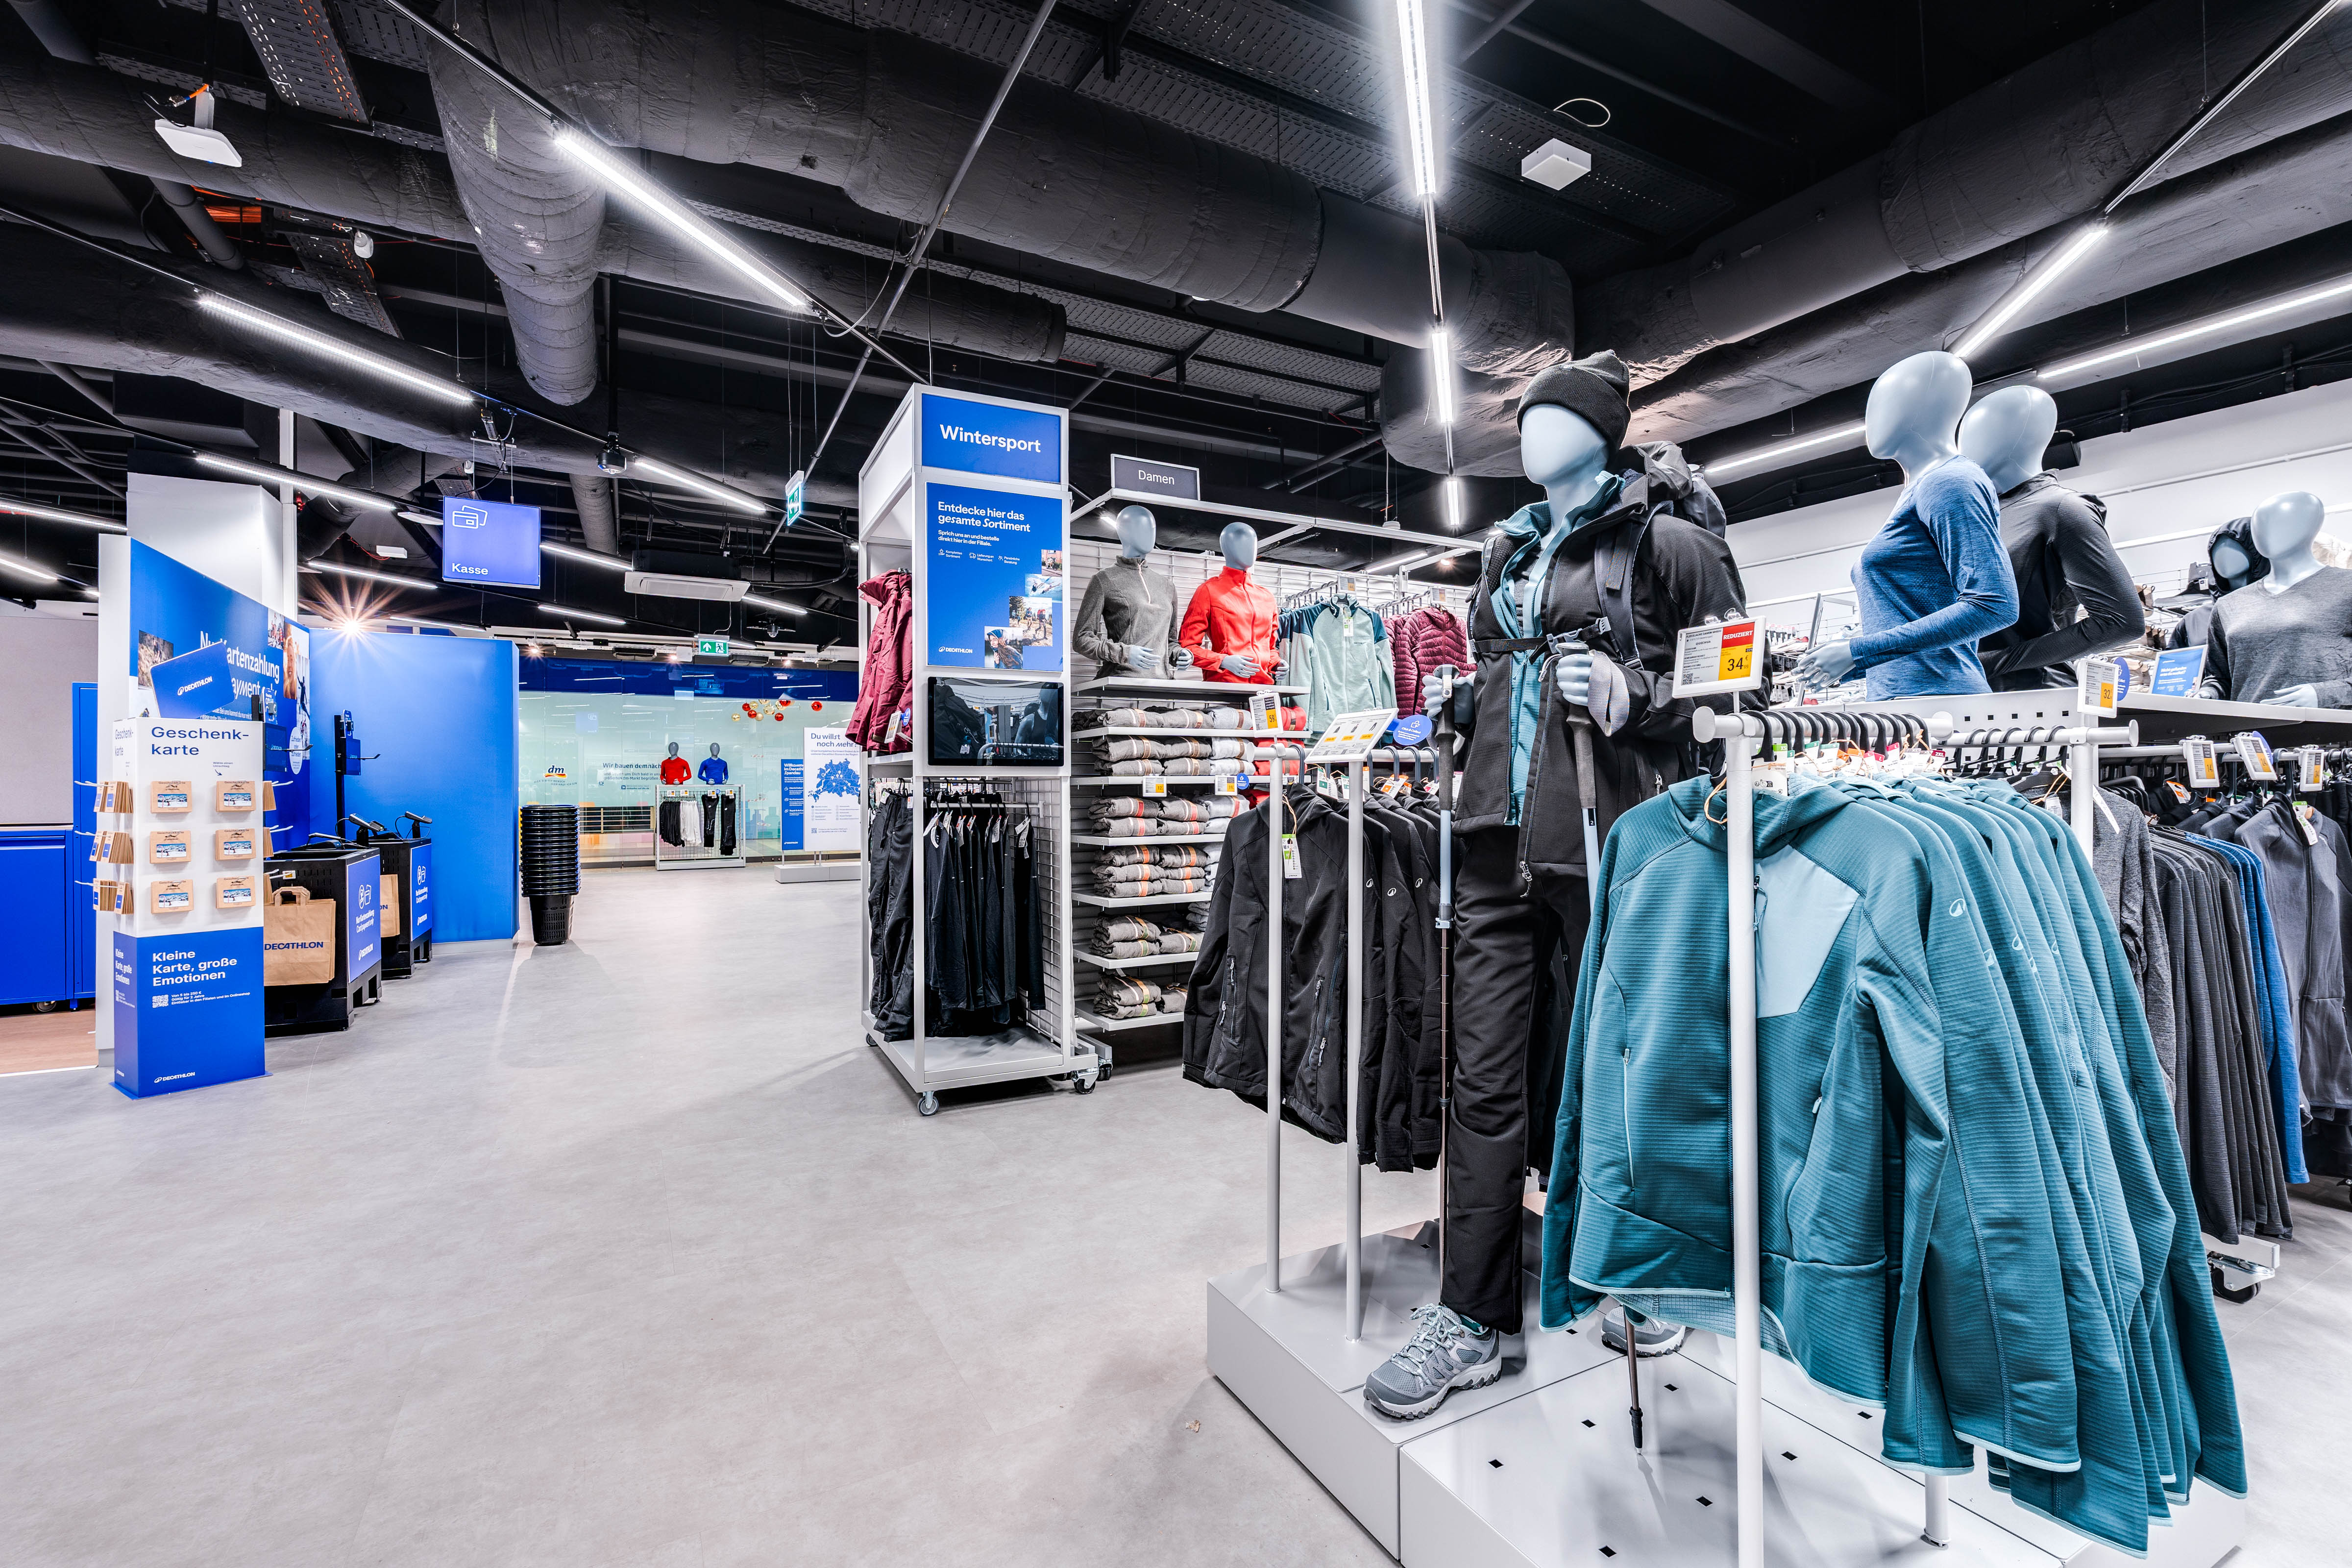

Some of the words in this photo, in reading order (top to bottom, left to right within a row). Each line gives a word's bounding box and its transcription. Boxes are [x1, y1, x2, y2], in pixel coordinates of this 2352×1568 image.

[939, 424, 1041, 453] Wintersport
[1138, 470, 1175, 485] Damen
[938, 501, 986, 516] Entdecke
[987, 508, 1006, 518] hier
[1007, 510, 1025, 520] das
[938, 514, 981, 527] gesamte
[982, 518, 1030, 532] Sortiment
[452, 563, 489, 575] Kasse
[1723, 630, 1753, 640] REDUZIERT
[220, 639, 280, 684] artenzahlung
[1727, 658, 1743, 671] 34
[184, 676, 212, 693] DECATHLON
[232, 677, 260, 700] ayment
[2104, 689, 2110, 699] 32
[115, 729, 133, 740] Geschenk-
[151, 727, 249, 740] Geschenk-
[115, 745, 123, 756] karte
[152, 744, 199, 756] karte
[548, 765, 564, 774] dm
[264, 941, 323, 950] DECATHLON
[115, 948, 124, 959] Kleine
[153, 951, 196, 962] Kleine
[153, 963, 195, 974] Karte,
[198, 958, 237, 971] große
[116, 972, 130, 985] Emotionen
[153, 971, 225, 987] Emotionen
[162, 1072, 196, 1082] DECATHLON
